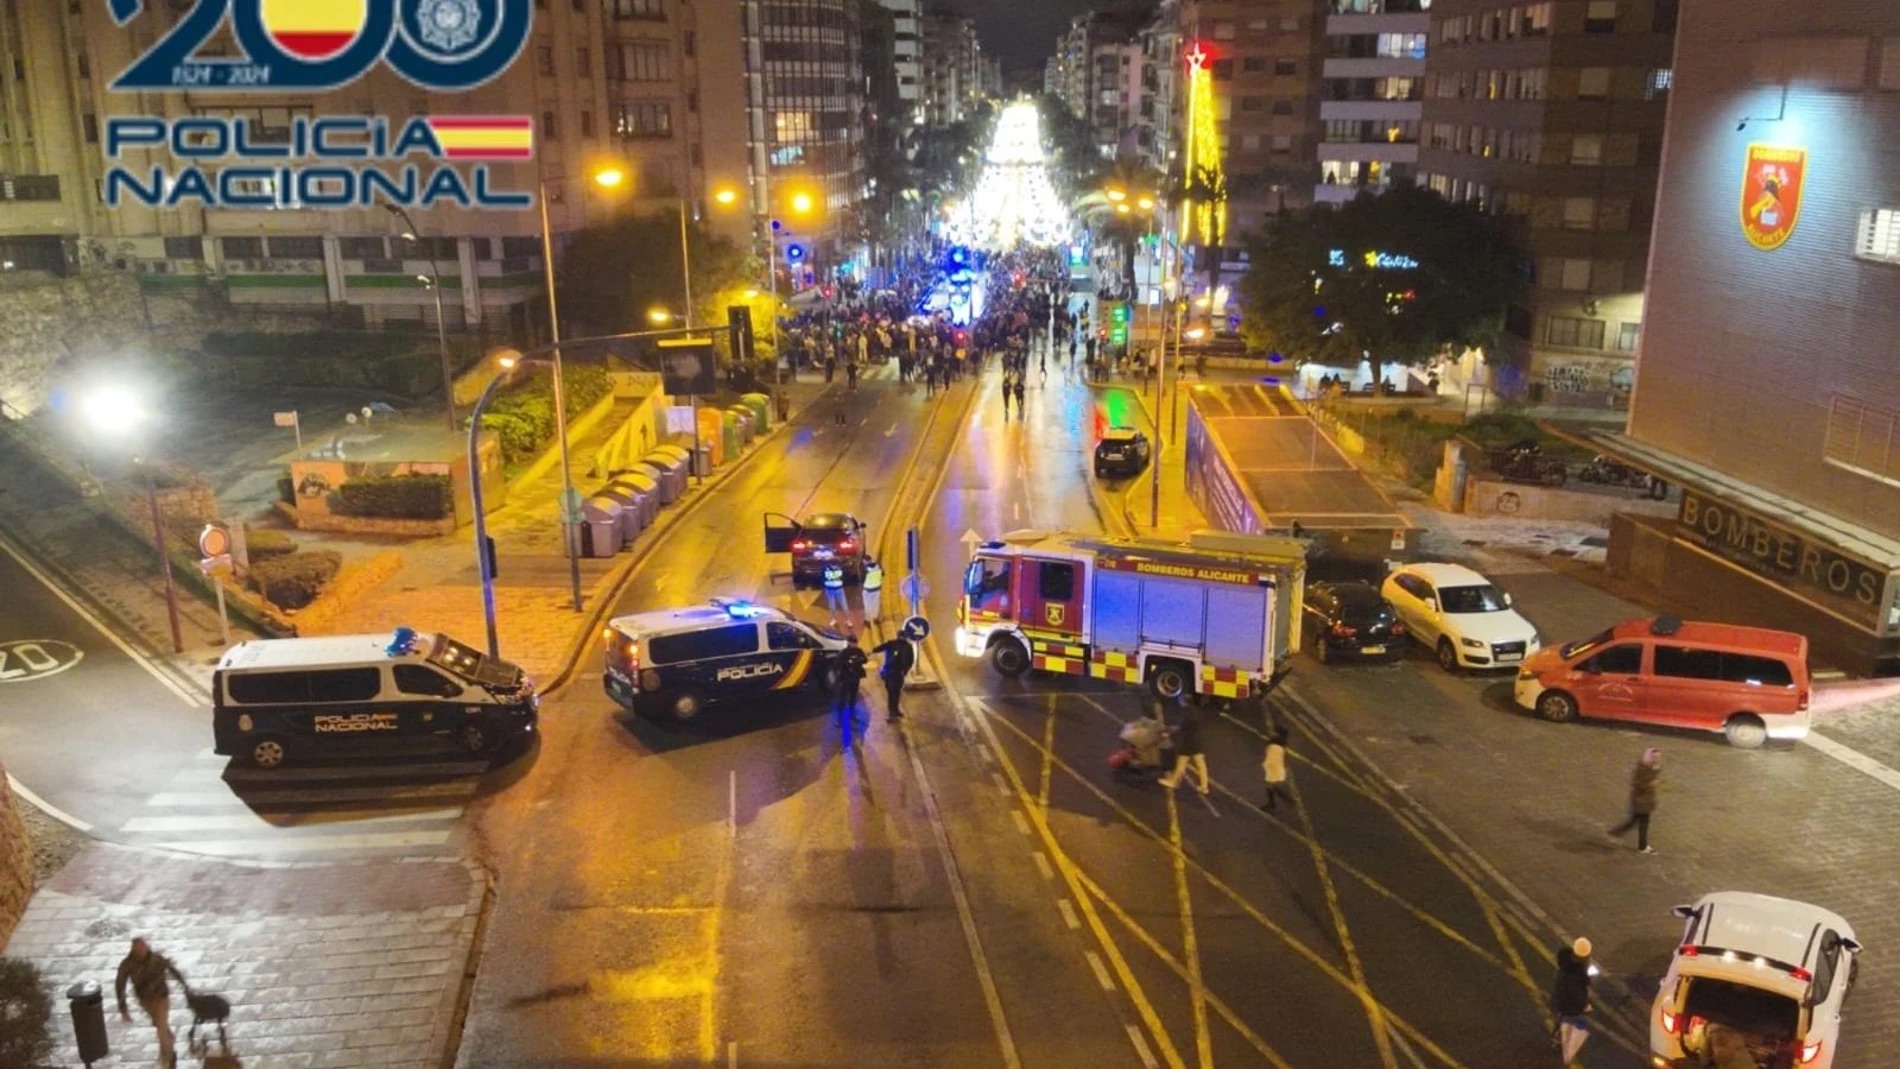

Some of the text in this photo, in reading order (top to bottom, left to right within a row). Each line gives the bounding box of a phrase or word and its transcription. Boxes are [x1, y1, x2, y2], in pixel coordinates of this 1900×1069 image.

[1683, 496, 1877, 604] BOMBEROS
[1137, 562, 1250, 583] BOMBEROS ALICANTE
[315, 721, 398, 732] NACIONAL
